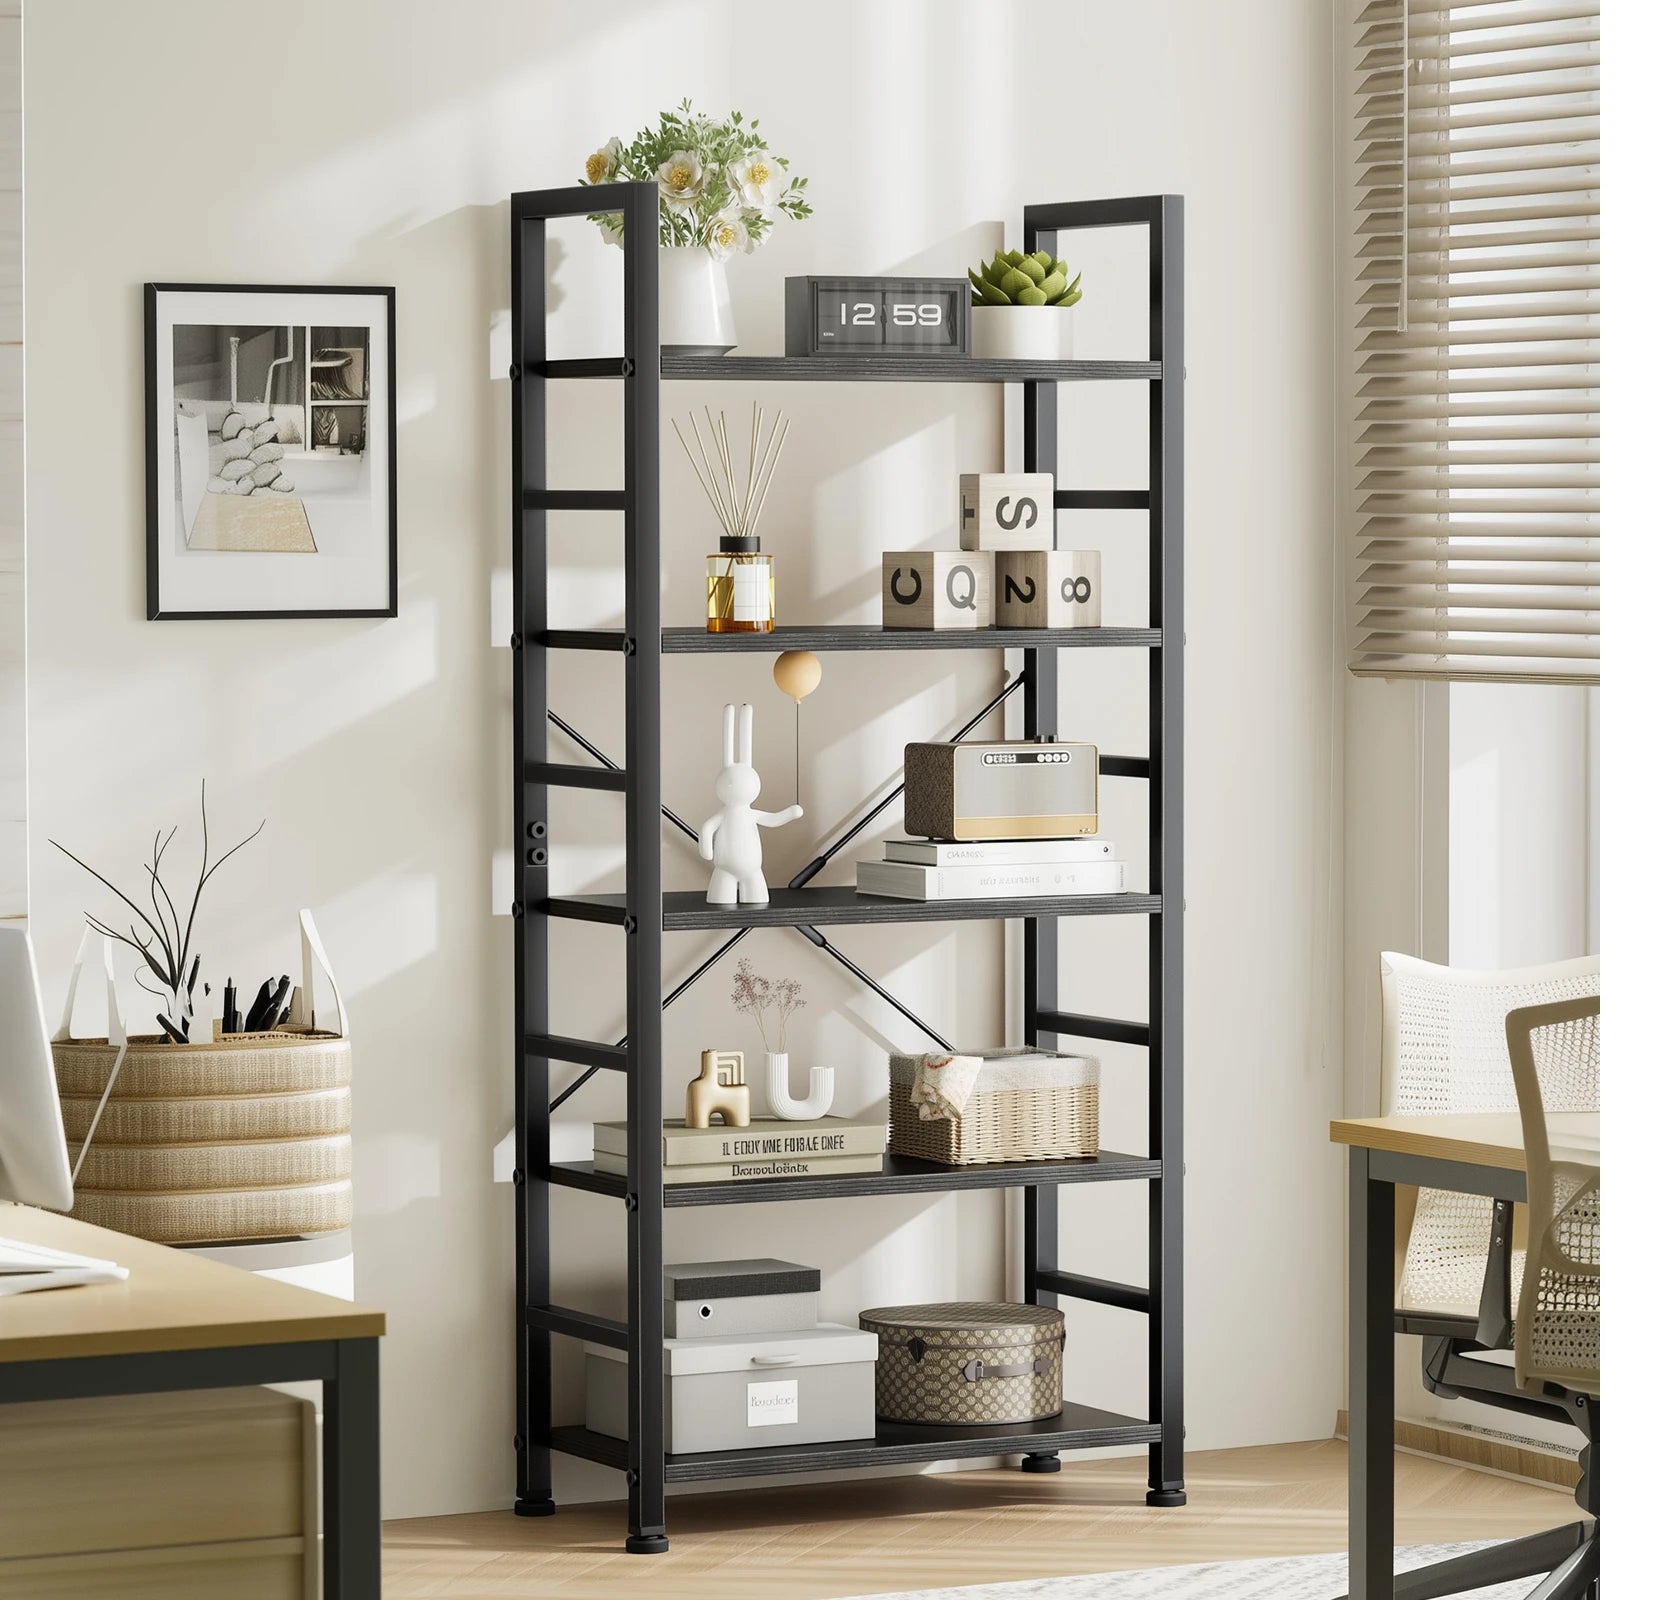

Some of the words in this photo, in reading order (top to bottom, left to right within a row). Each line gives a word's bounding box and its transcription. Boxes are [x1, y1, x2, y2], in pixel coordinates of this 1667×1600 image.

[840, 302, 876, 326] 12
[892, 303, 942, 326] 59
[996, 495, 1038, 531] S
[890, 567, 922, 605] C
[946, 564, 977, 611] Q
[1005, 574, 1036, 604] 2
[1060, 576, 1091, 604] 8
